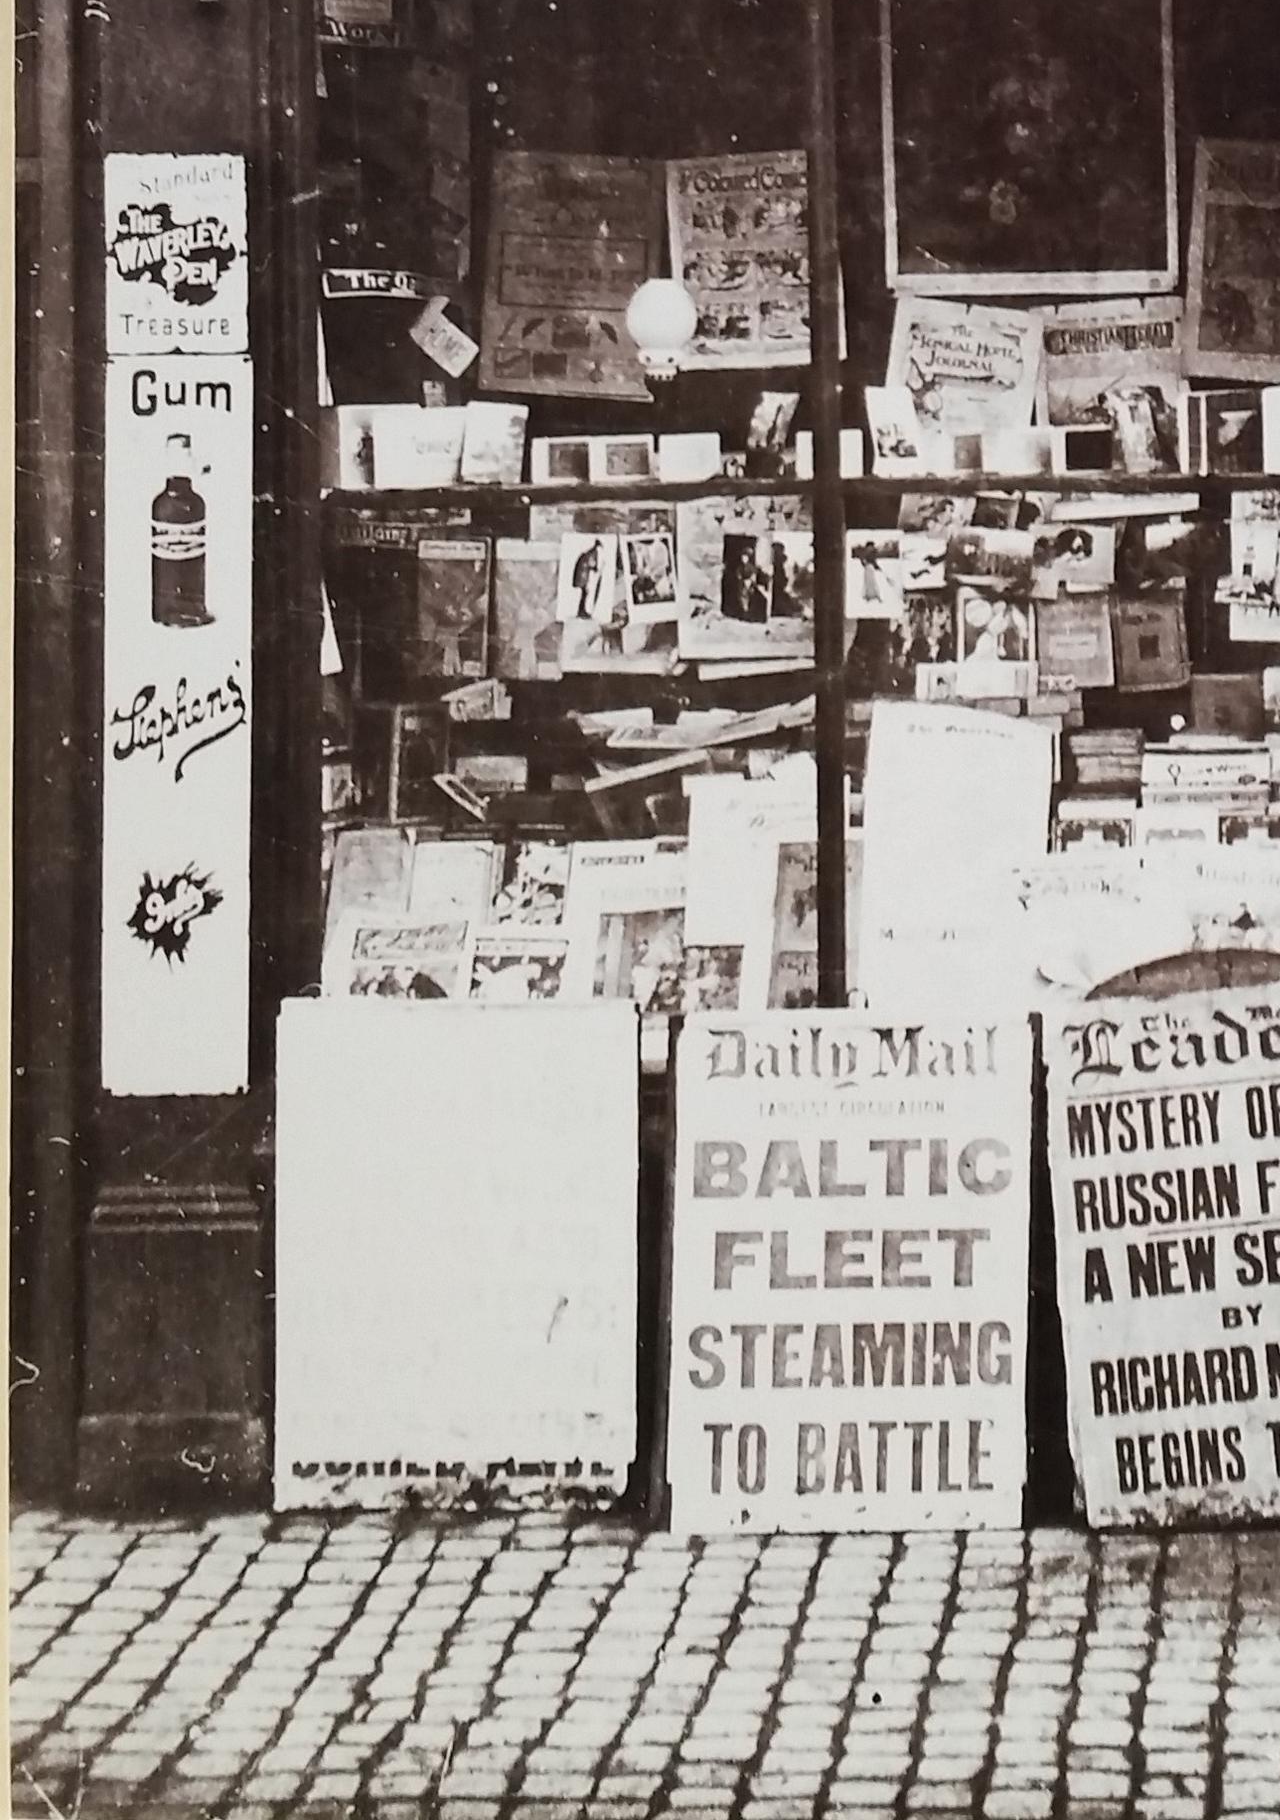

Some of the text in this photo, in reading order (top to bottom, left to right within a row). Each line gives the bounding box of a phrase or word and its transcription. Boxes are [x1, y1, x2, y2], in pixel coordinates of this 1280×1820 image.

[114, 220, 232, 274] WAVERLEY
[127, 206, 164, 234] THE
[162, 255, 218, 288] PEN
[120, 313, 231, 336] Treasure
[131, 369, 232, 417] Gum
[706, 1025, 998, 1089] Daily Mail
[1066, 1089, 1221, 1159] MYSTERY
[693, 1137, 1013, 1199] BALTIC
[1074, 1163, 1242, 1233] RUSSIAN
[713, 1228, 991, 1291] FLEET
[1083, 1245, 1114, 1304] A
[1126, 1233, 1217, 1300] NEW
[1221, 1302, 1264, 1329] BY
[688, 1320, 1013, 1390] STEAMING
[1090, 1343, 1259, 1418] RICHARD
[703, 1418, 994, 1497] TO BATTLE
[1115, 1423, 1246, 1495] BEGINS
